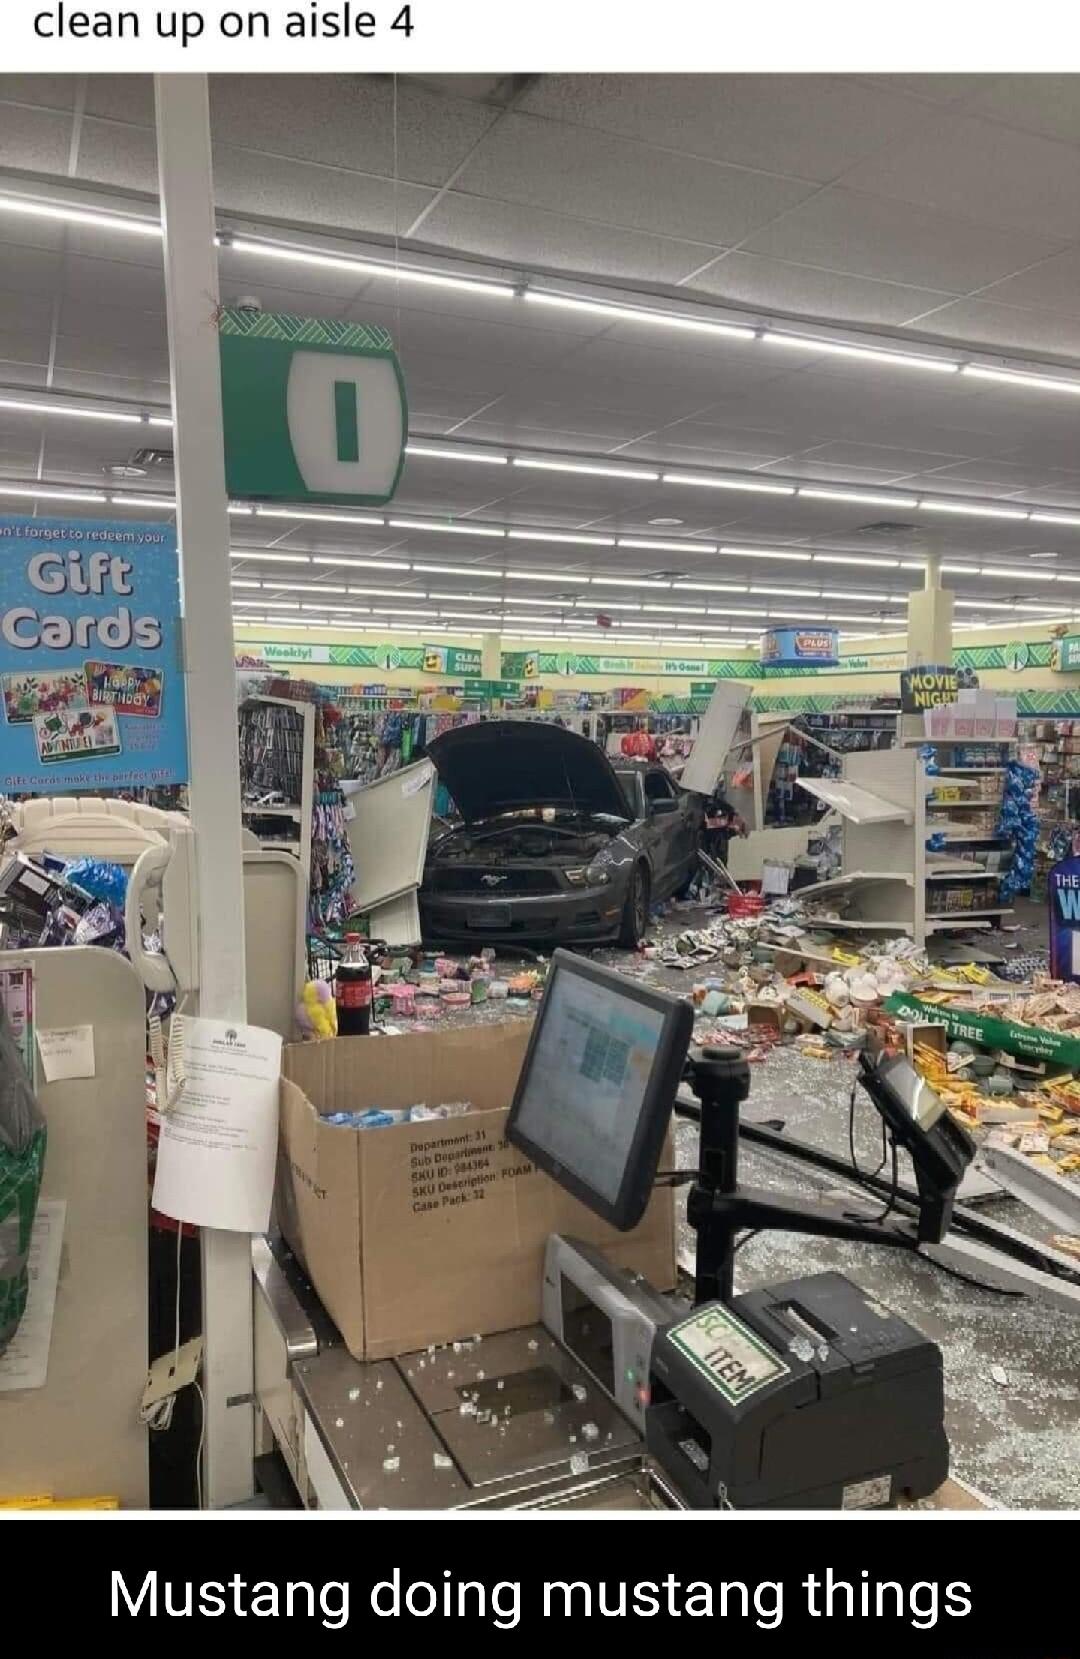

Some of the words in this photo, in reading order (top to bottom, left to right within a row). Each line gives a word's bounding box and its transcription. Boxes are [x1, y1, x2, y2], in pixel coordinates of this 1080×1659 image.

[24, 526, 66, 541] forget
[69, 529, 83, 540] to
[86, 531, 135, 543] redeem
[137, 534, 165, 545] your
[28, 550, 133, 596] Gift
[2, 607, 162, 650] Cards
[263, 646, 312, 659] Weekly!
[911, 674, 958, 690] MOVIE
[1054, 873, 1079, 888] THE
[953, 1022, 984, 1042] TREE
[410, 1133, 472, 1153] Department:
[410, 1156, 432, 1168] Sub
[411, 1171, 434, 1183] SKU
[412, 1186, 435, 1198] SKU
[502, 1165, 532, 1179] FOAM
[412, 1201, 439, 1213] Case
[704, 1346, 756, 1391] ITEM
